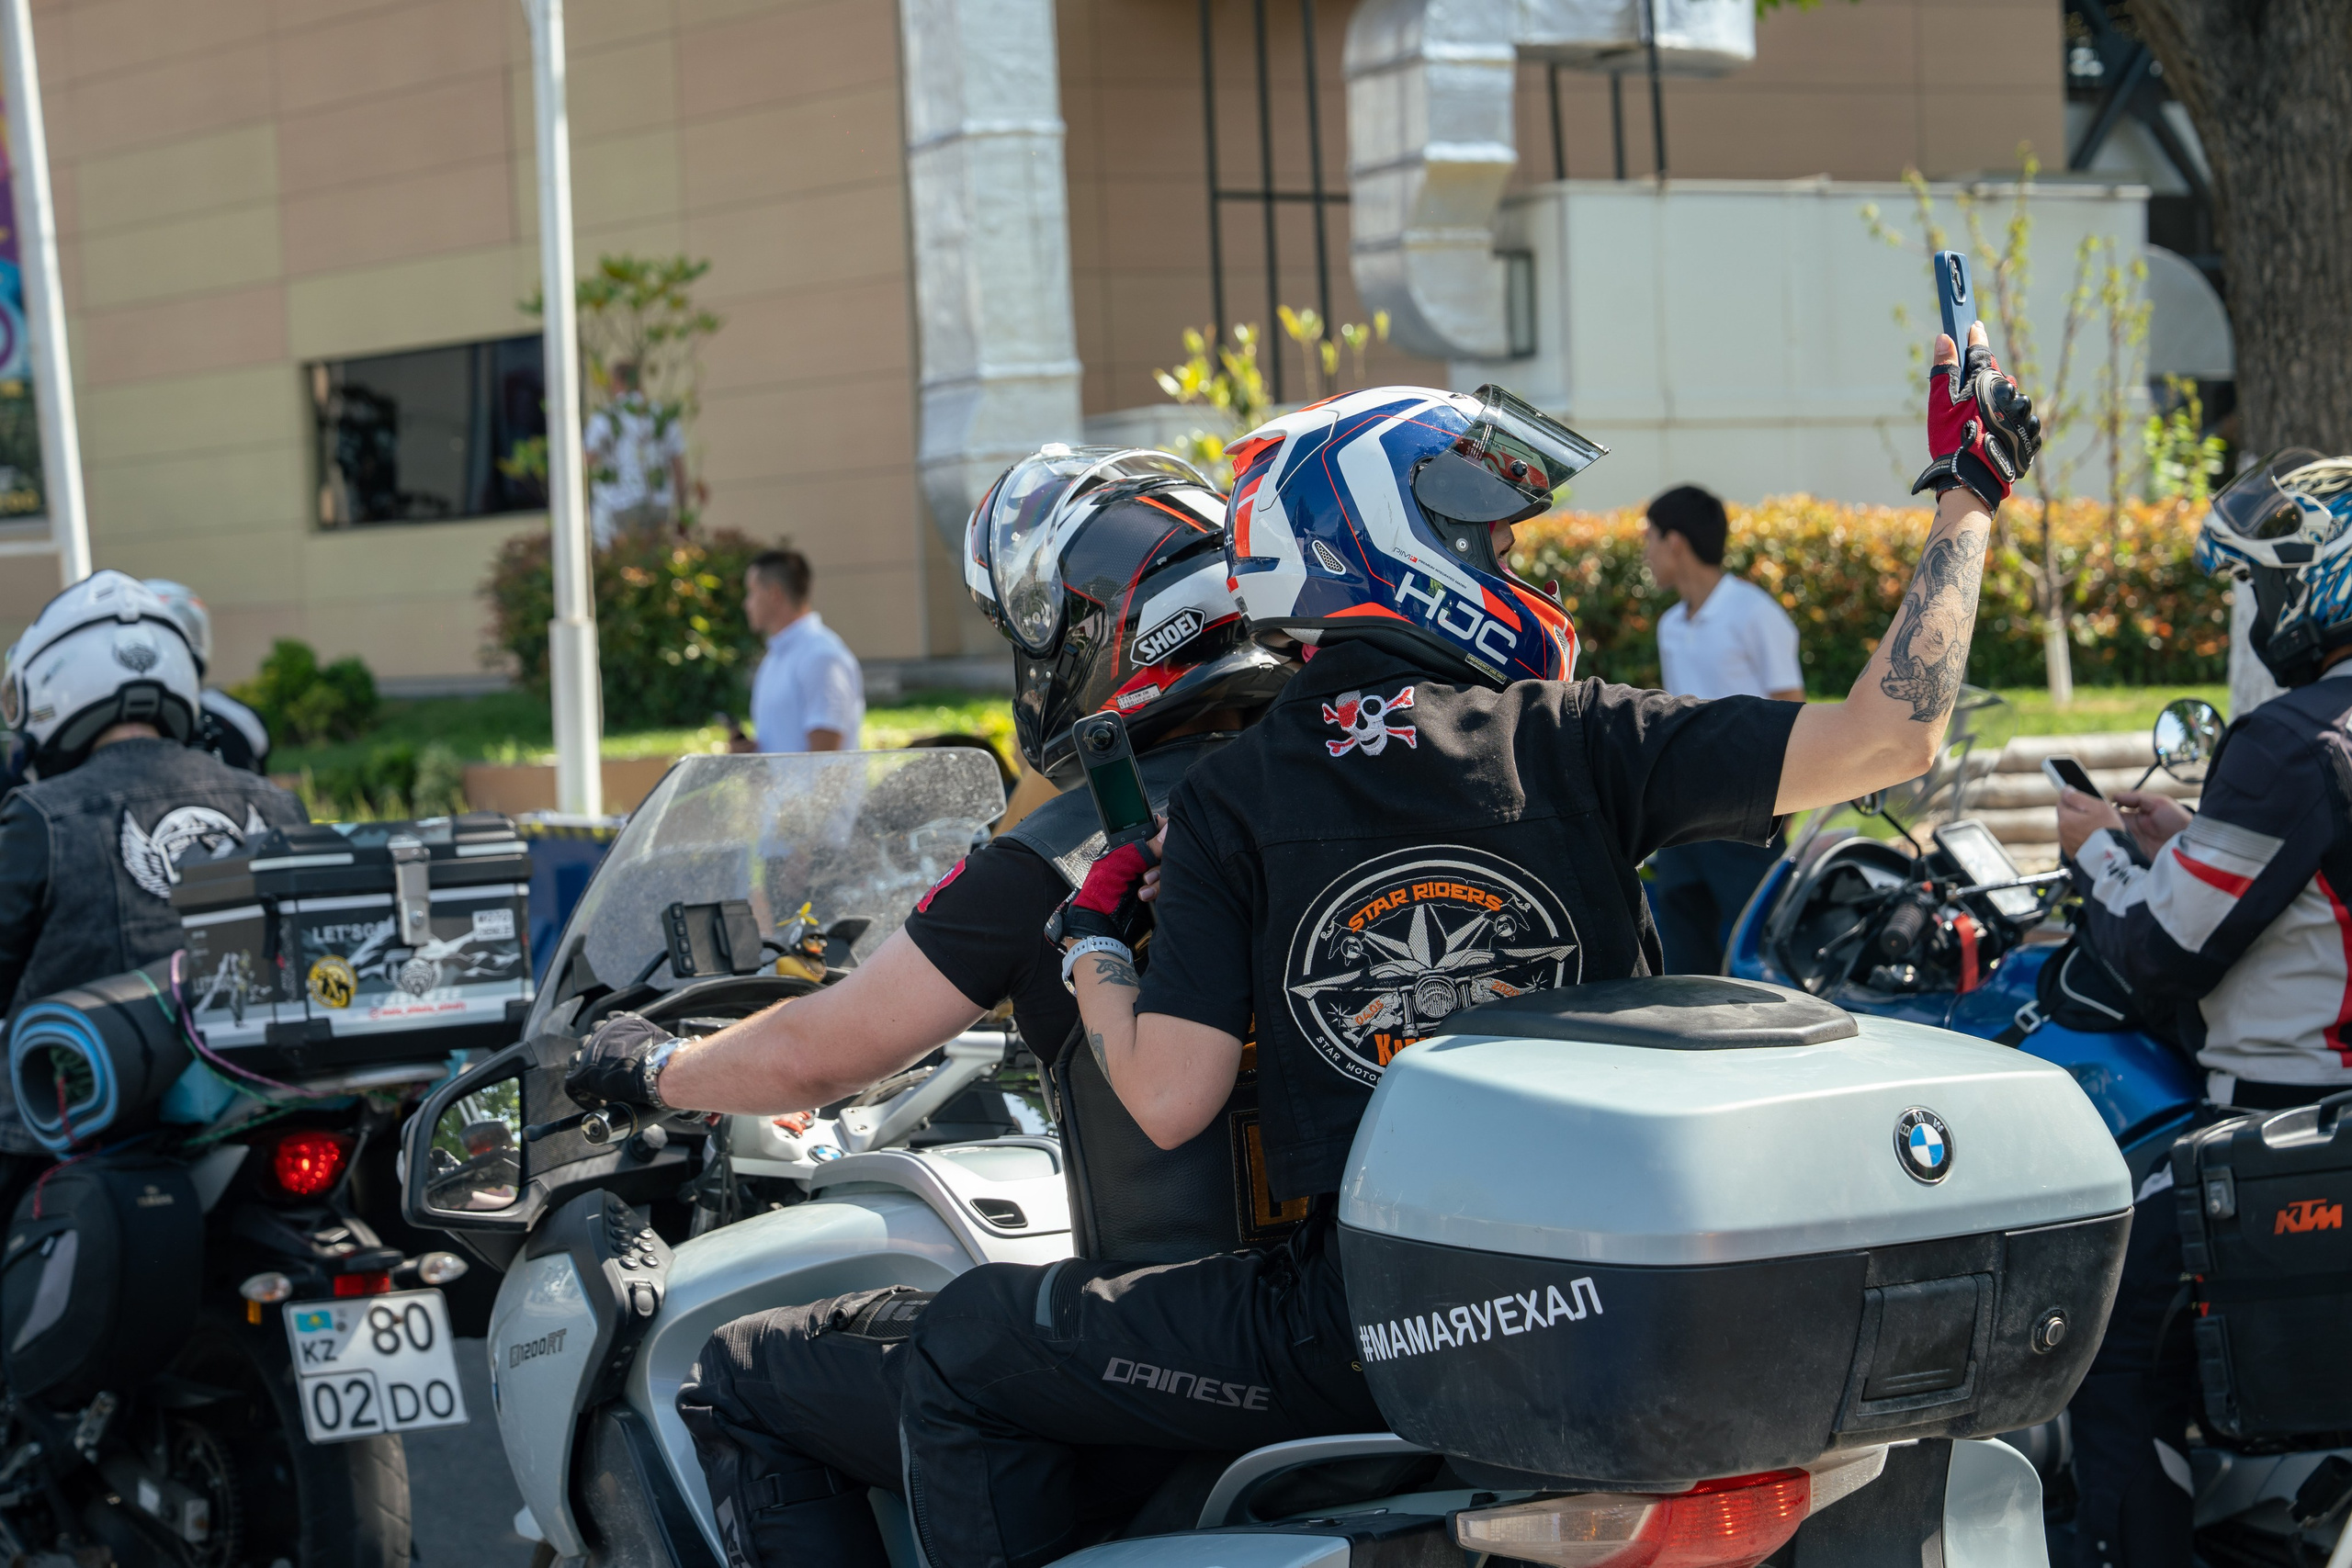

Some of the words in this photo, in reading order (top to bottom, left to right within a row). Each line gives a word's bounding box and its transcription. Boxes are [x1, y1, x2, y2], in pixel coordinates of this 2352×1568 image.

[1138, 613, 1199, 661] SHOEI
[1395, 571, 1517, 665] HJC
[1348, 887, 1409, 934] STAR
[1411, 881, 1504, 912] RIDERS
[1354, 998, 1385, 1026] 04.05
[1316, 1035, 1341, 1062] STAR
[1898, 1111, 1945, 1138] BMW
[2273, 1198, 2343, 1235] KTM
[368, 1302, 435, 1356] 80
[1359, 1276, 1604, 1363] #МАМАЯУЕХАЛ
[300, 1338, 338, 1364] KZ
[312, 1379, 378, 1431] 02
[388, 1379, 456, 1424] DO
[1102, 1356, 1272, 1412] DAINESE
